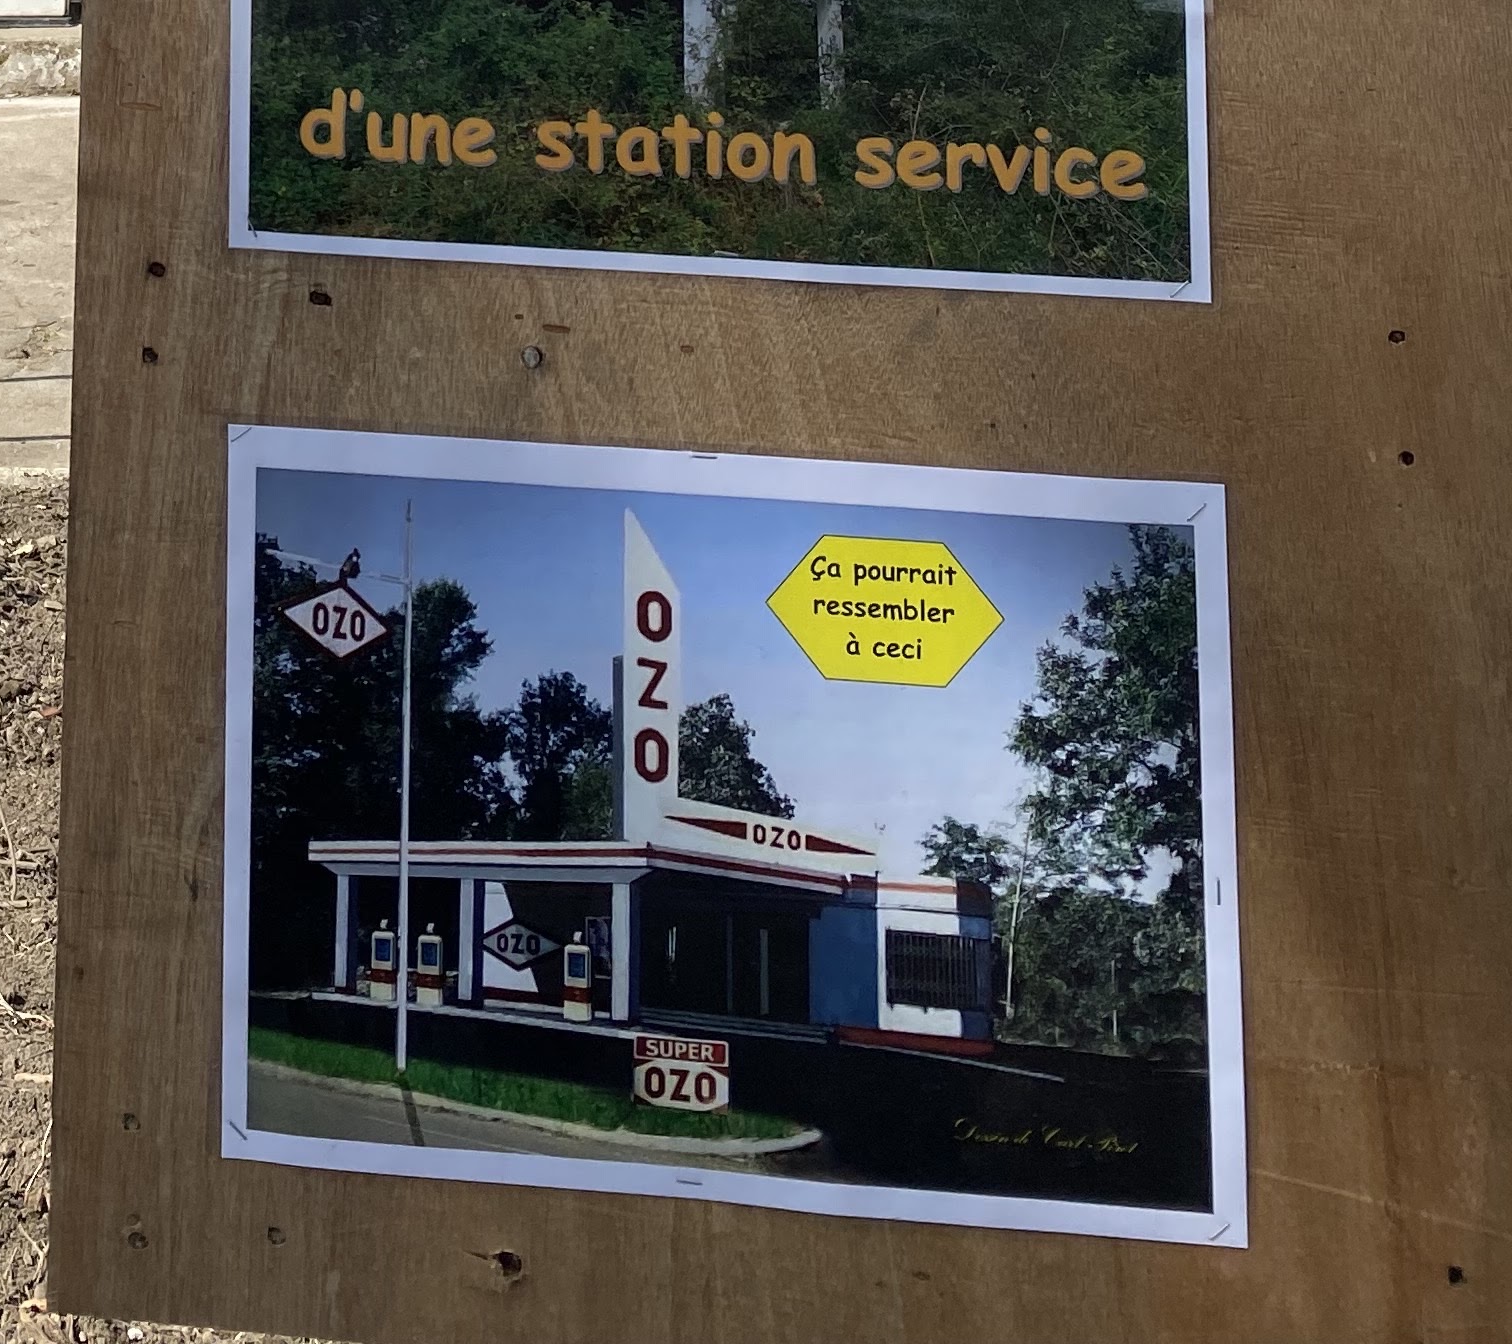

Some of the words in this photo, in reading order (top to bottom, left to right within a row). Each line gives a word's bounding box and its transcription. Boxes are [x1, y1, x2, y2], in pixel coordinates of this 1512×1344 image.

[299, 88, 498, 167] d'une
[534, 109, 818, 185] station
[855, 128, 1149, 200] service
[810, 555, 841, 581] Ça
[854, 563, 957, 586] pourrait
[312, 602, 366, 642] OZO
[813, 598, 955, 624] ressembler
[846, 631, 861, 656] à
[872, 638, 922, 660] ceci
[634, 590, 673, 783] OZO
[753, 823, 801, 851] OZO
[496, 933, 541, 955] OZO
[645, 1039, 715, 1061] SUPER
[644, 1066, 717, 1105] OZO
